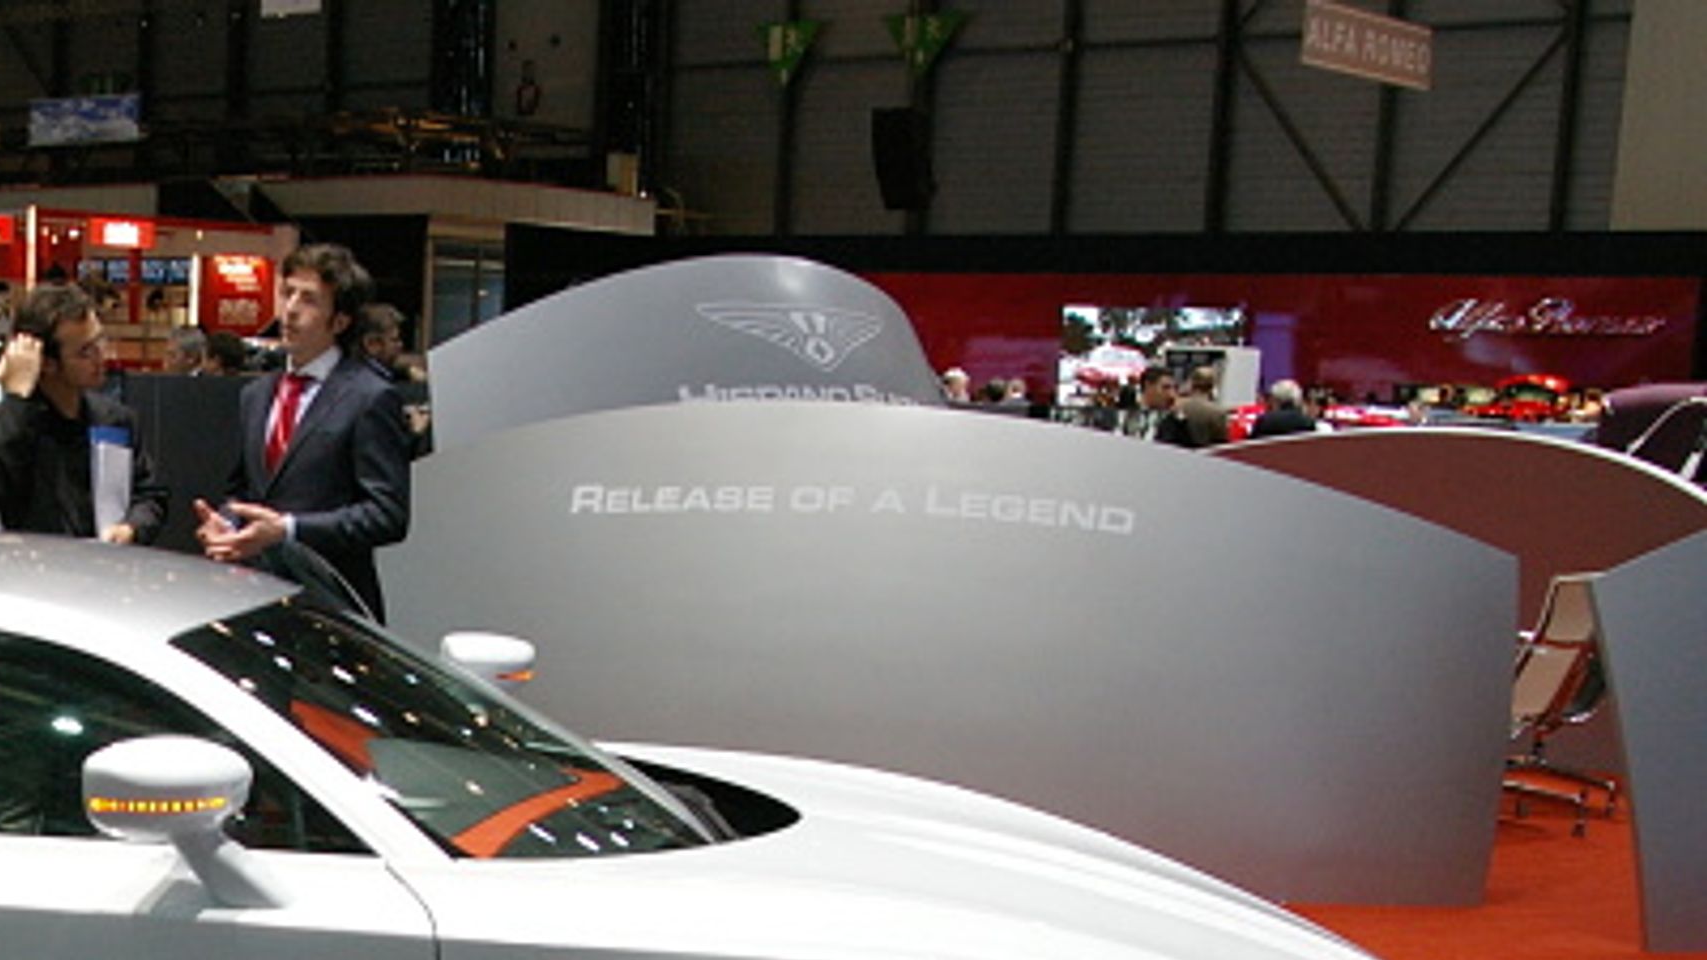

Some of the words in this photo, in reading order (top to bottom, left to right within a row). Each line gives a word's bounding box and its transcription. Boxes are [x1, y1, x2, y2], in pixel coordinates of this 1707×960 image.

[1304, 17, 1357, 53] ALFA
[1361, 29, 1431, 74] ROMEO
[569, 483, 775, 515] RELEASE
[789, 485, 856, 514] OF
[871, 488, 907, 514] A
[924, 485, 1138, 535] LEGEND
